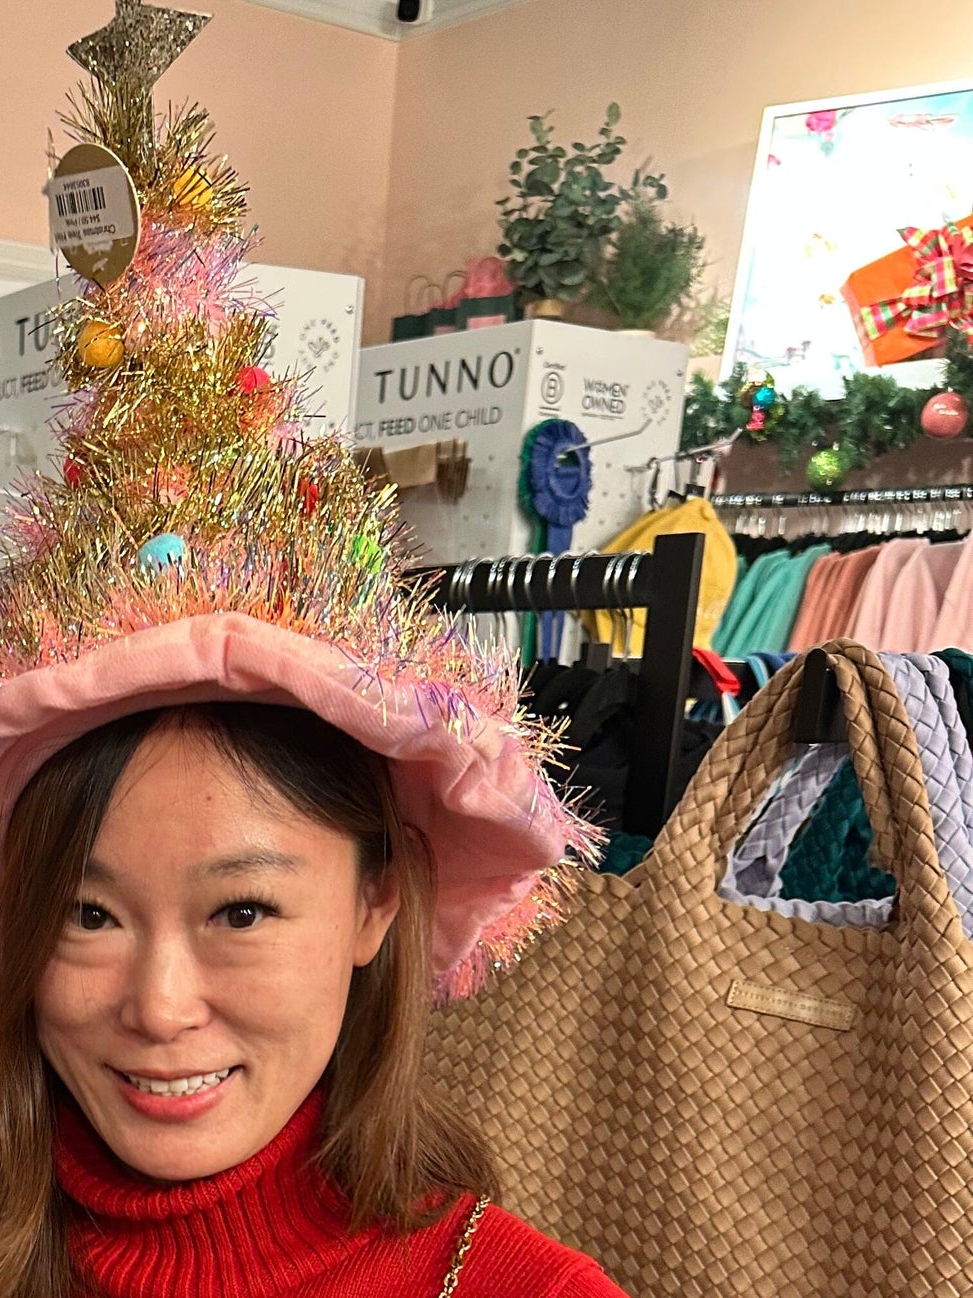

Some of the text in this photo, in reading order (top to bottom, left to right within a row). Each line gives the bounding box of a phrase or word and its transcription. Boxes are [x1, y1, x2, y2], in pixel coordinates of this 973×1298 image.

[67, 228, 82, 240] Tree
[83, 224, 116, 237] Christmas
[20, 370, 48, 394] FEED
[374, 351, 514, 404] TUNNO
[581, 394, 627, 415] OWNED
[378, 417, 416, 437] FEED
[418, 411, 451, 433] ONE
[455, 406, 503, 429] CHILD
